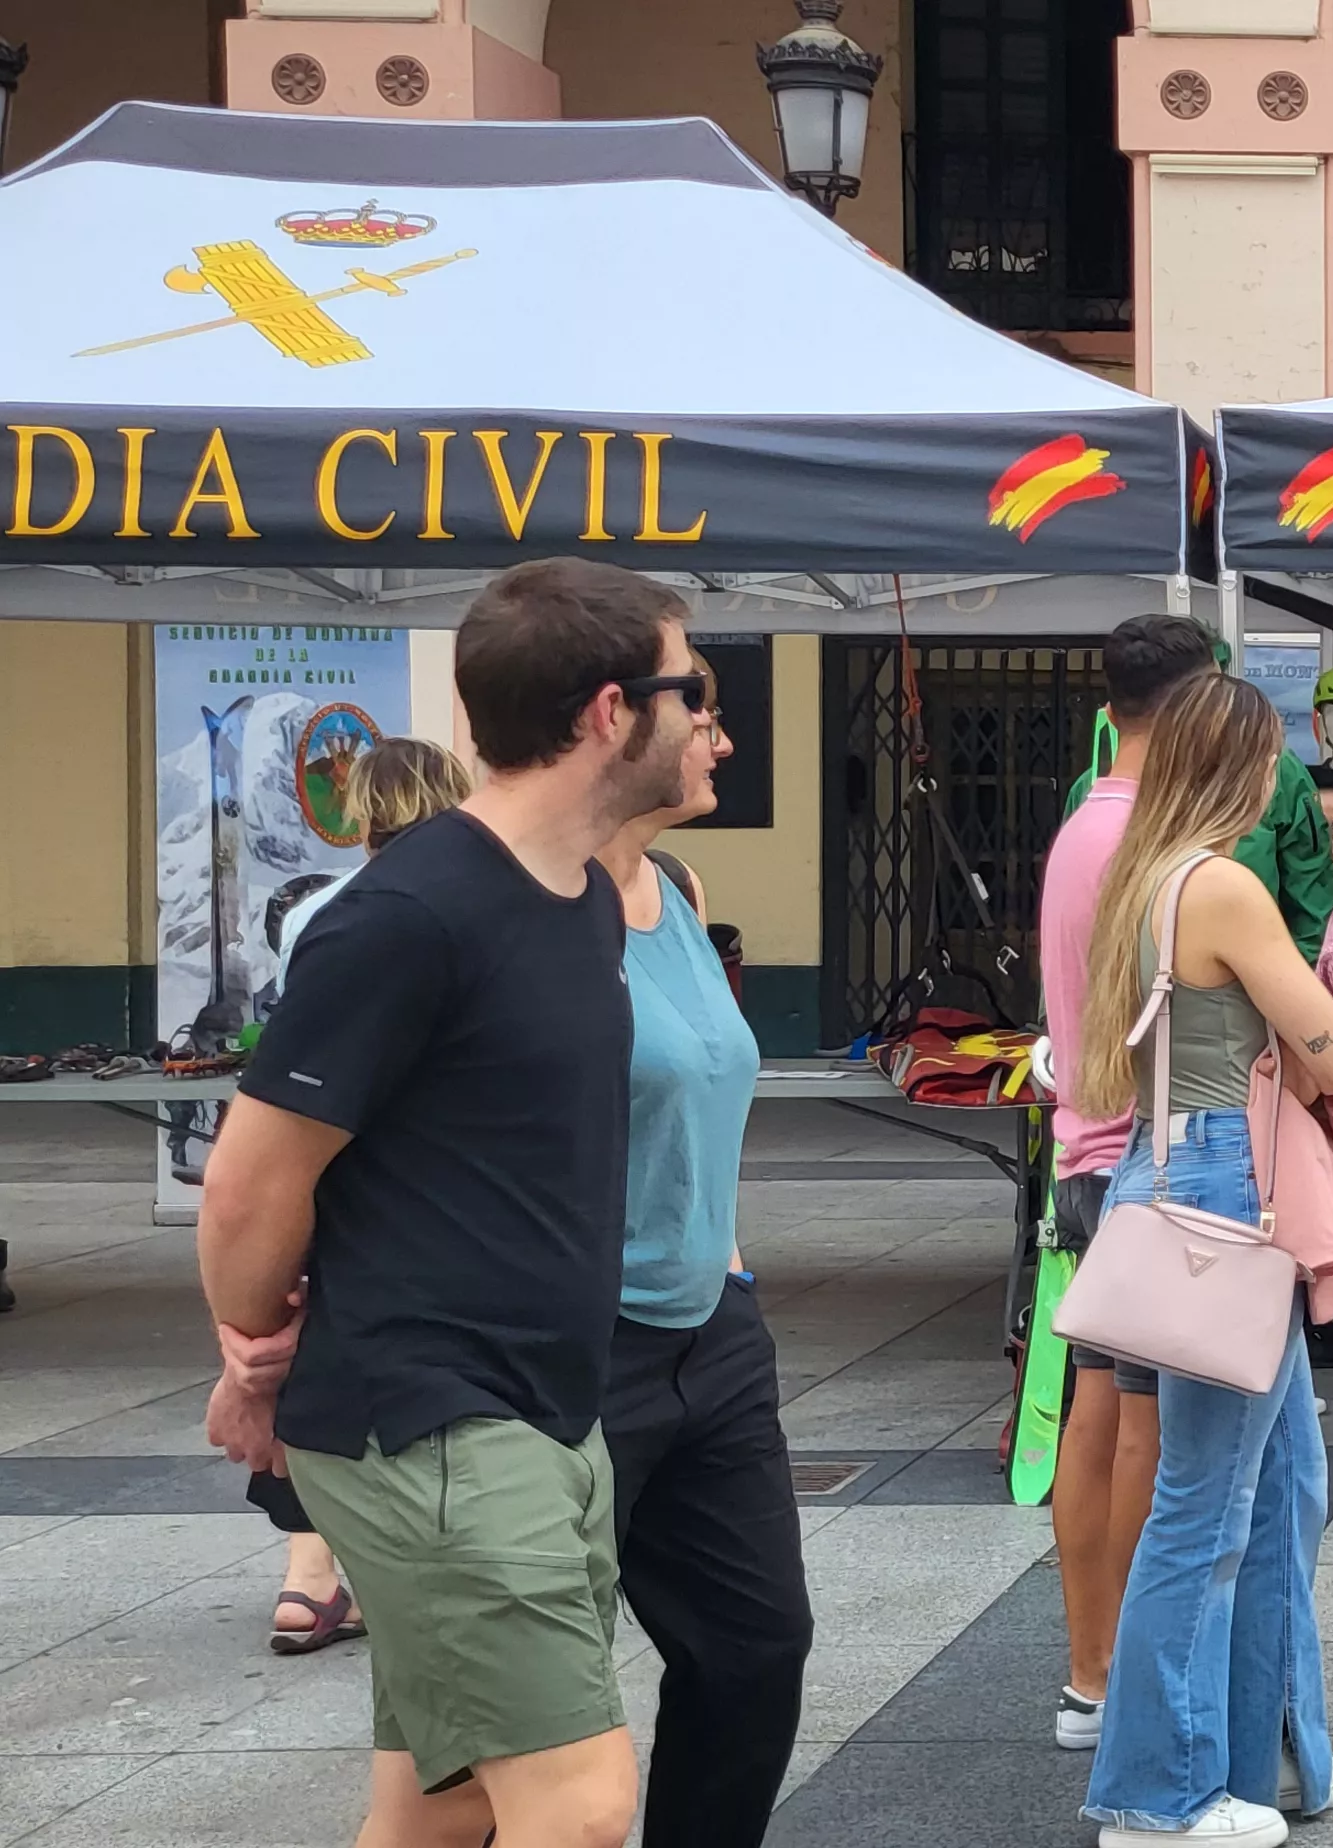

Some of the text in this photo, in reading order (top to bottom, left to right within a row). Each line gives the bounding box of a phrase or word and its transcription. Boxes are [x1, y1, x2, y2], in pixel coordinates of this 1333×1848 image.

[5, 424, 708, 541] DIA CIVIL
[256, 649, 309, 662] DE LA
[209, 669, 356, 684] GUARDIA CIVIL
